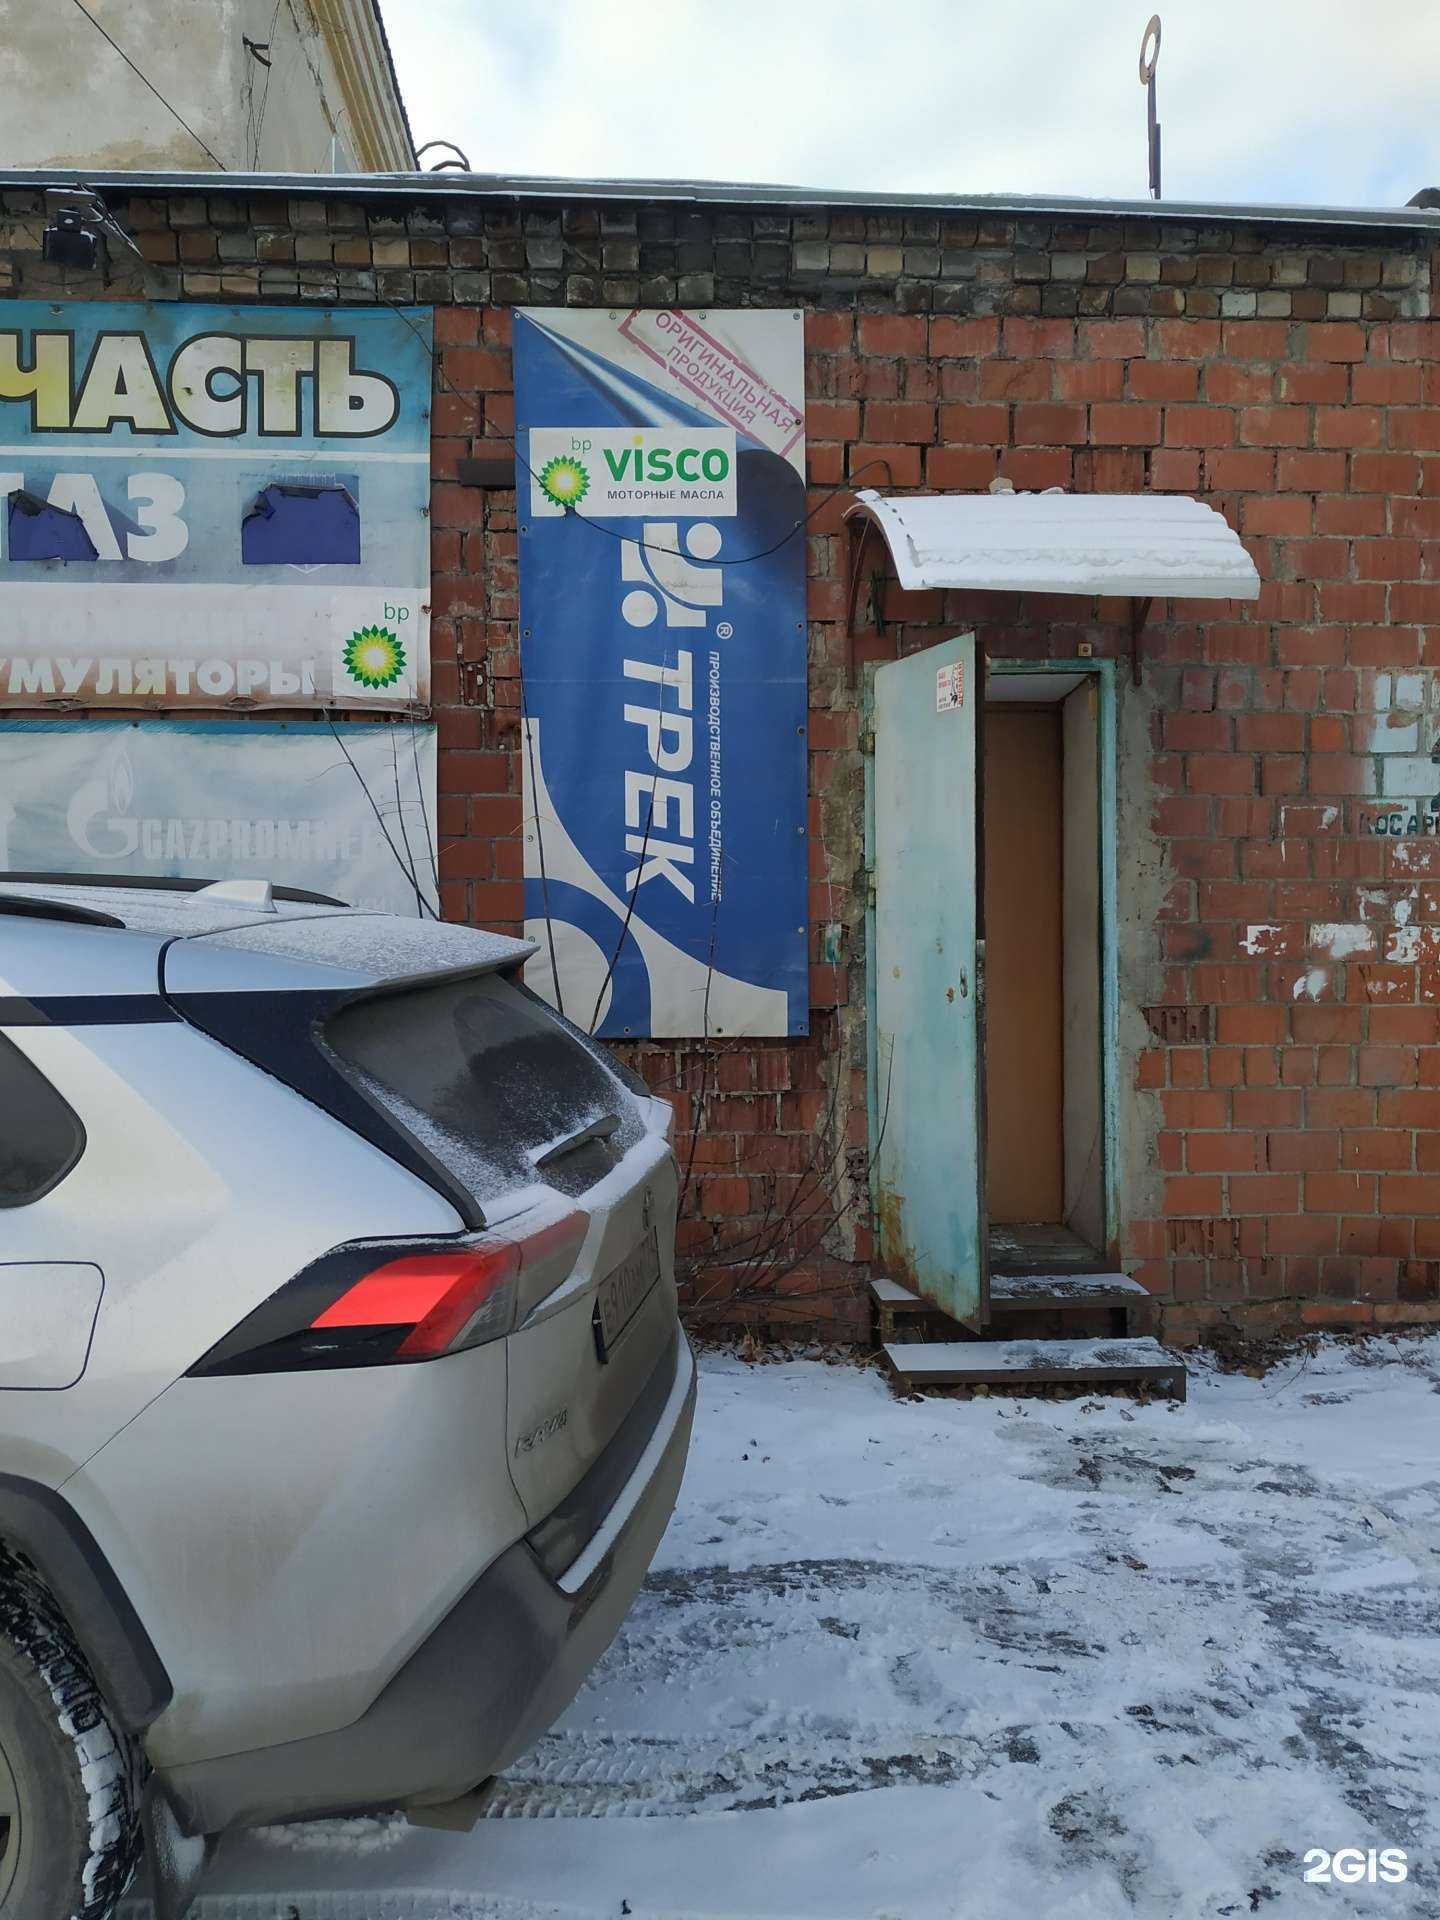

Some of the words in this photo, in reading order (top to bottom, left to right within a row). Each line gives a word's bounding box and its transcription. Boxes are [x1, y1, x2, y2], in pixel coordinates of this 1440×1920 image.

[655, 310, 795, 435] ОРИГИНАЛЬНАЯ
[666, 346, 757, 425] ПРОДУКЦИЯ
[570, 436, 592, 451] bp
[607, 489, 677, 500] МОТОРНЫЕ
[680, 489, 725, 500] МАСЛА
[383, 601, 410, 622] bp
[0, 656, 316, 696] МУЛЯТОРЫ
[708, 650, 722, 797] ПРОИЗВОДСТВЕННОЕ
[623, 649, 696, 905] ТРЕК
[709, 800, 723, 903] ОБЪЕДИНЕНИЕ
